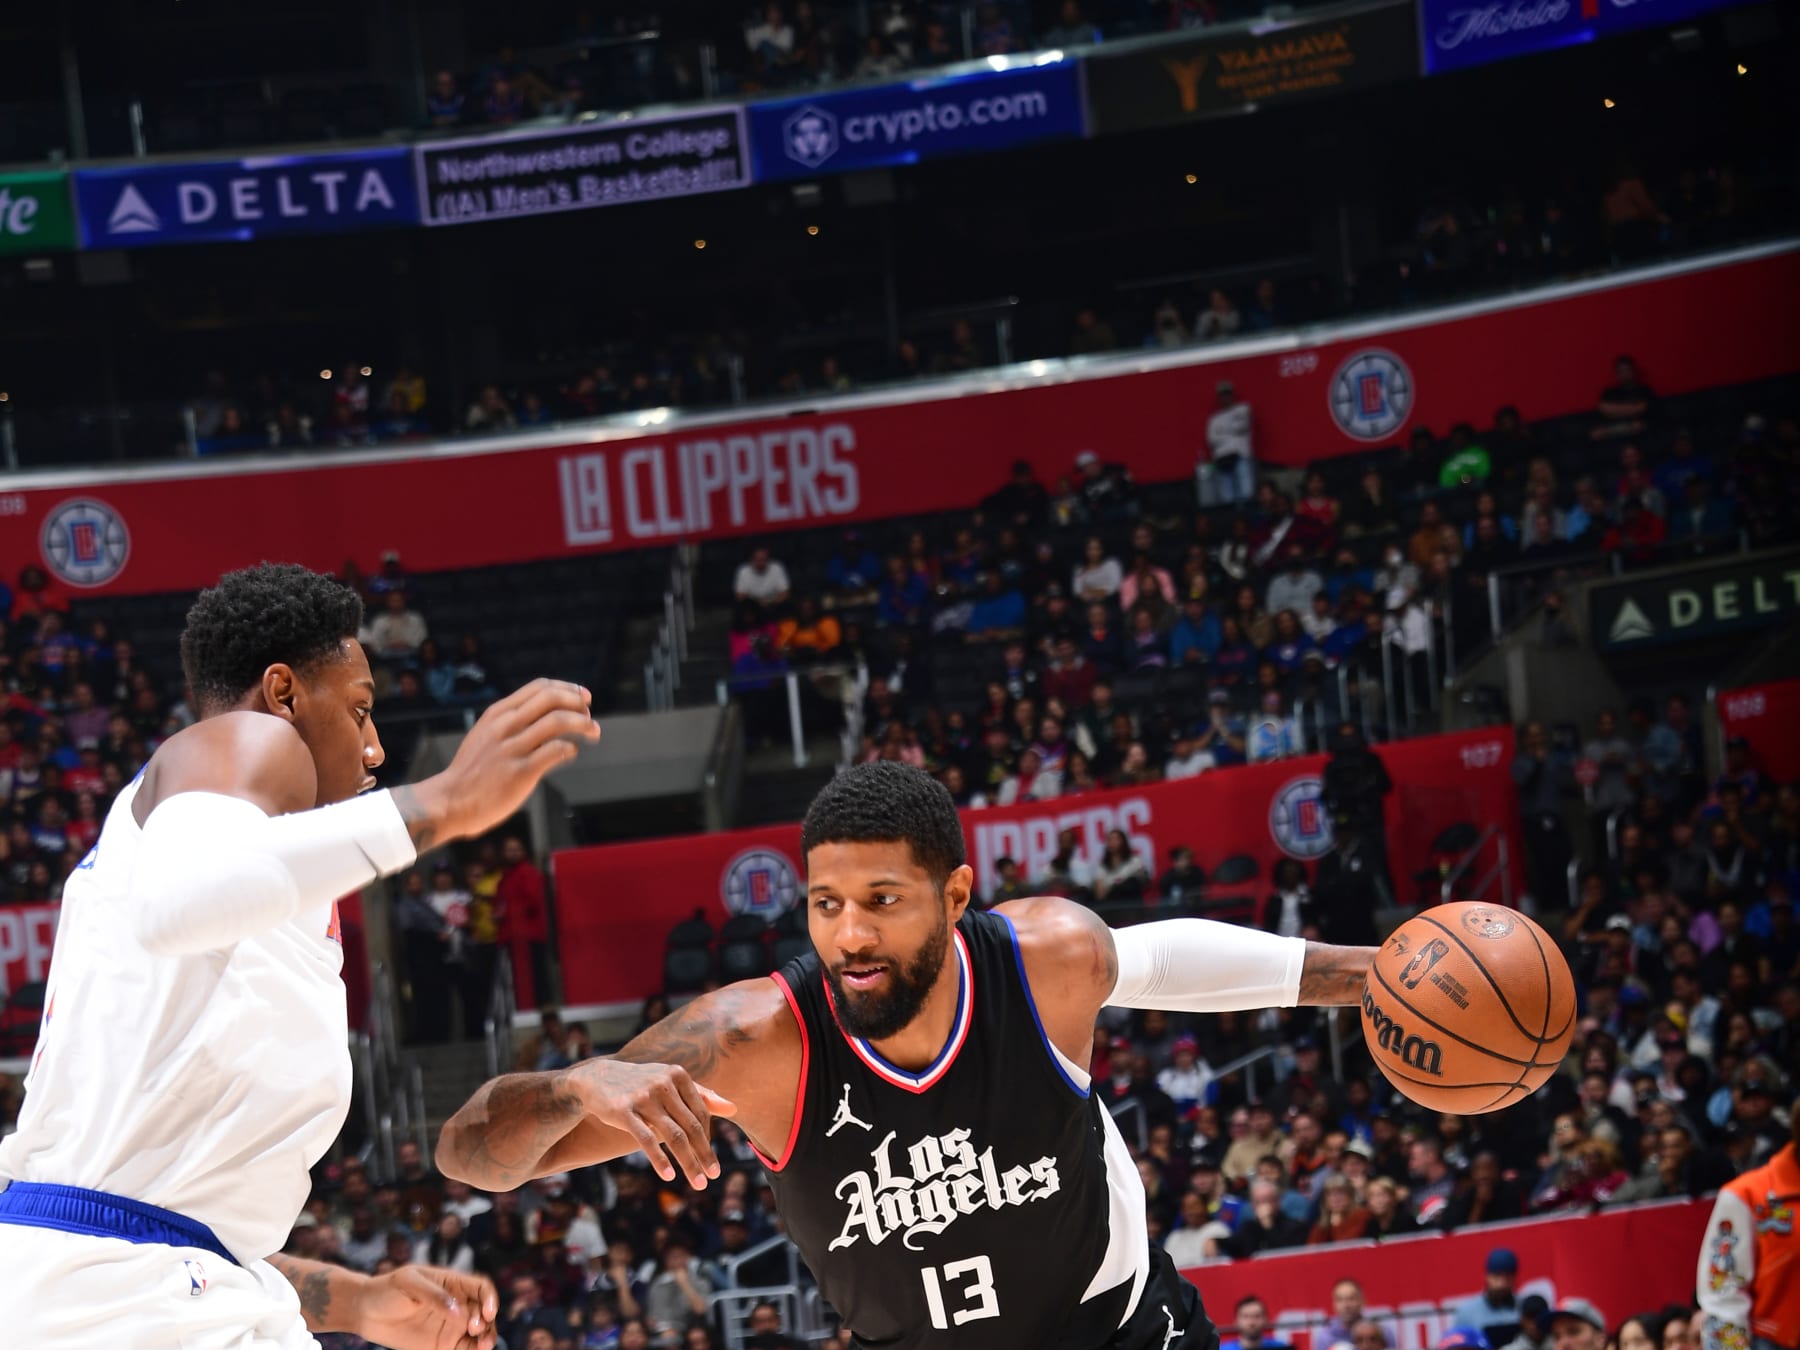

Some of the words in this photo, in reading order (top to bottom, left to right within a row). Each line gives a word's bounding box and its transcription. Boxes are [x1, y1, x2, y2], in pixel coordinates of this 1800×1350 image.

[843, 91, 1047, 143] crypto.com
[437, 141, 622, 184] Northwestern
[625, 127, 731, 160] College
[178, 168, 395, 224] DELTA
[491, 180, 573, 212] Men's
[559, 452, 613, 546] LA
[621, 424, 860, 538] CLIPPERS
[1459, 741, 1503, 770] 107
[870, 1127, 979, 1197] Los
[828, 1145, 1061, 1251] Angeles
[921, 1254, 1001, 1330] 13
